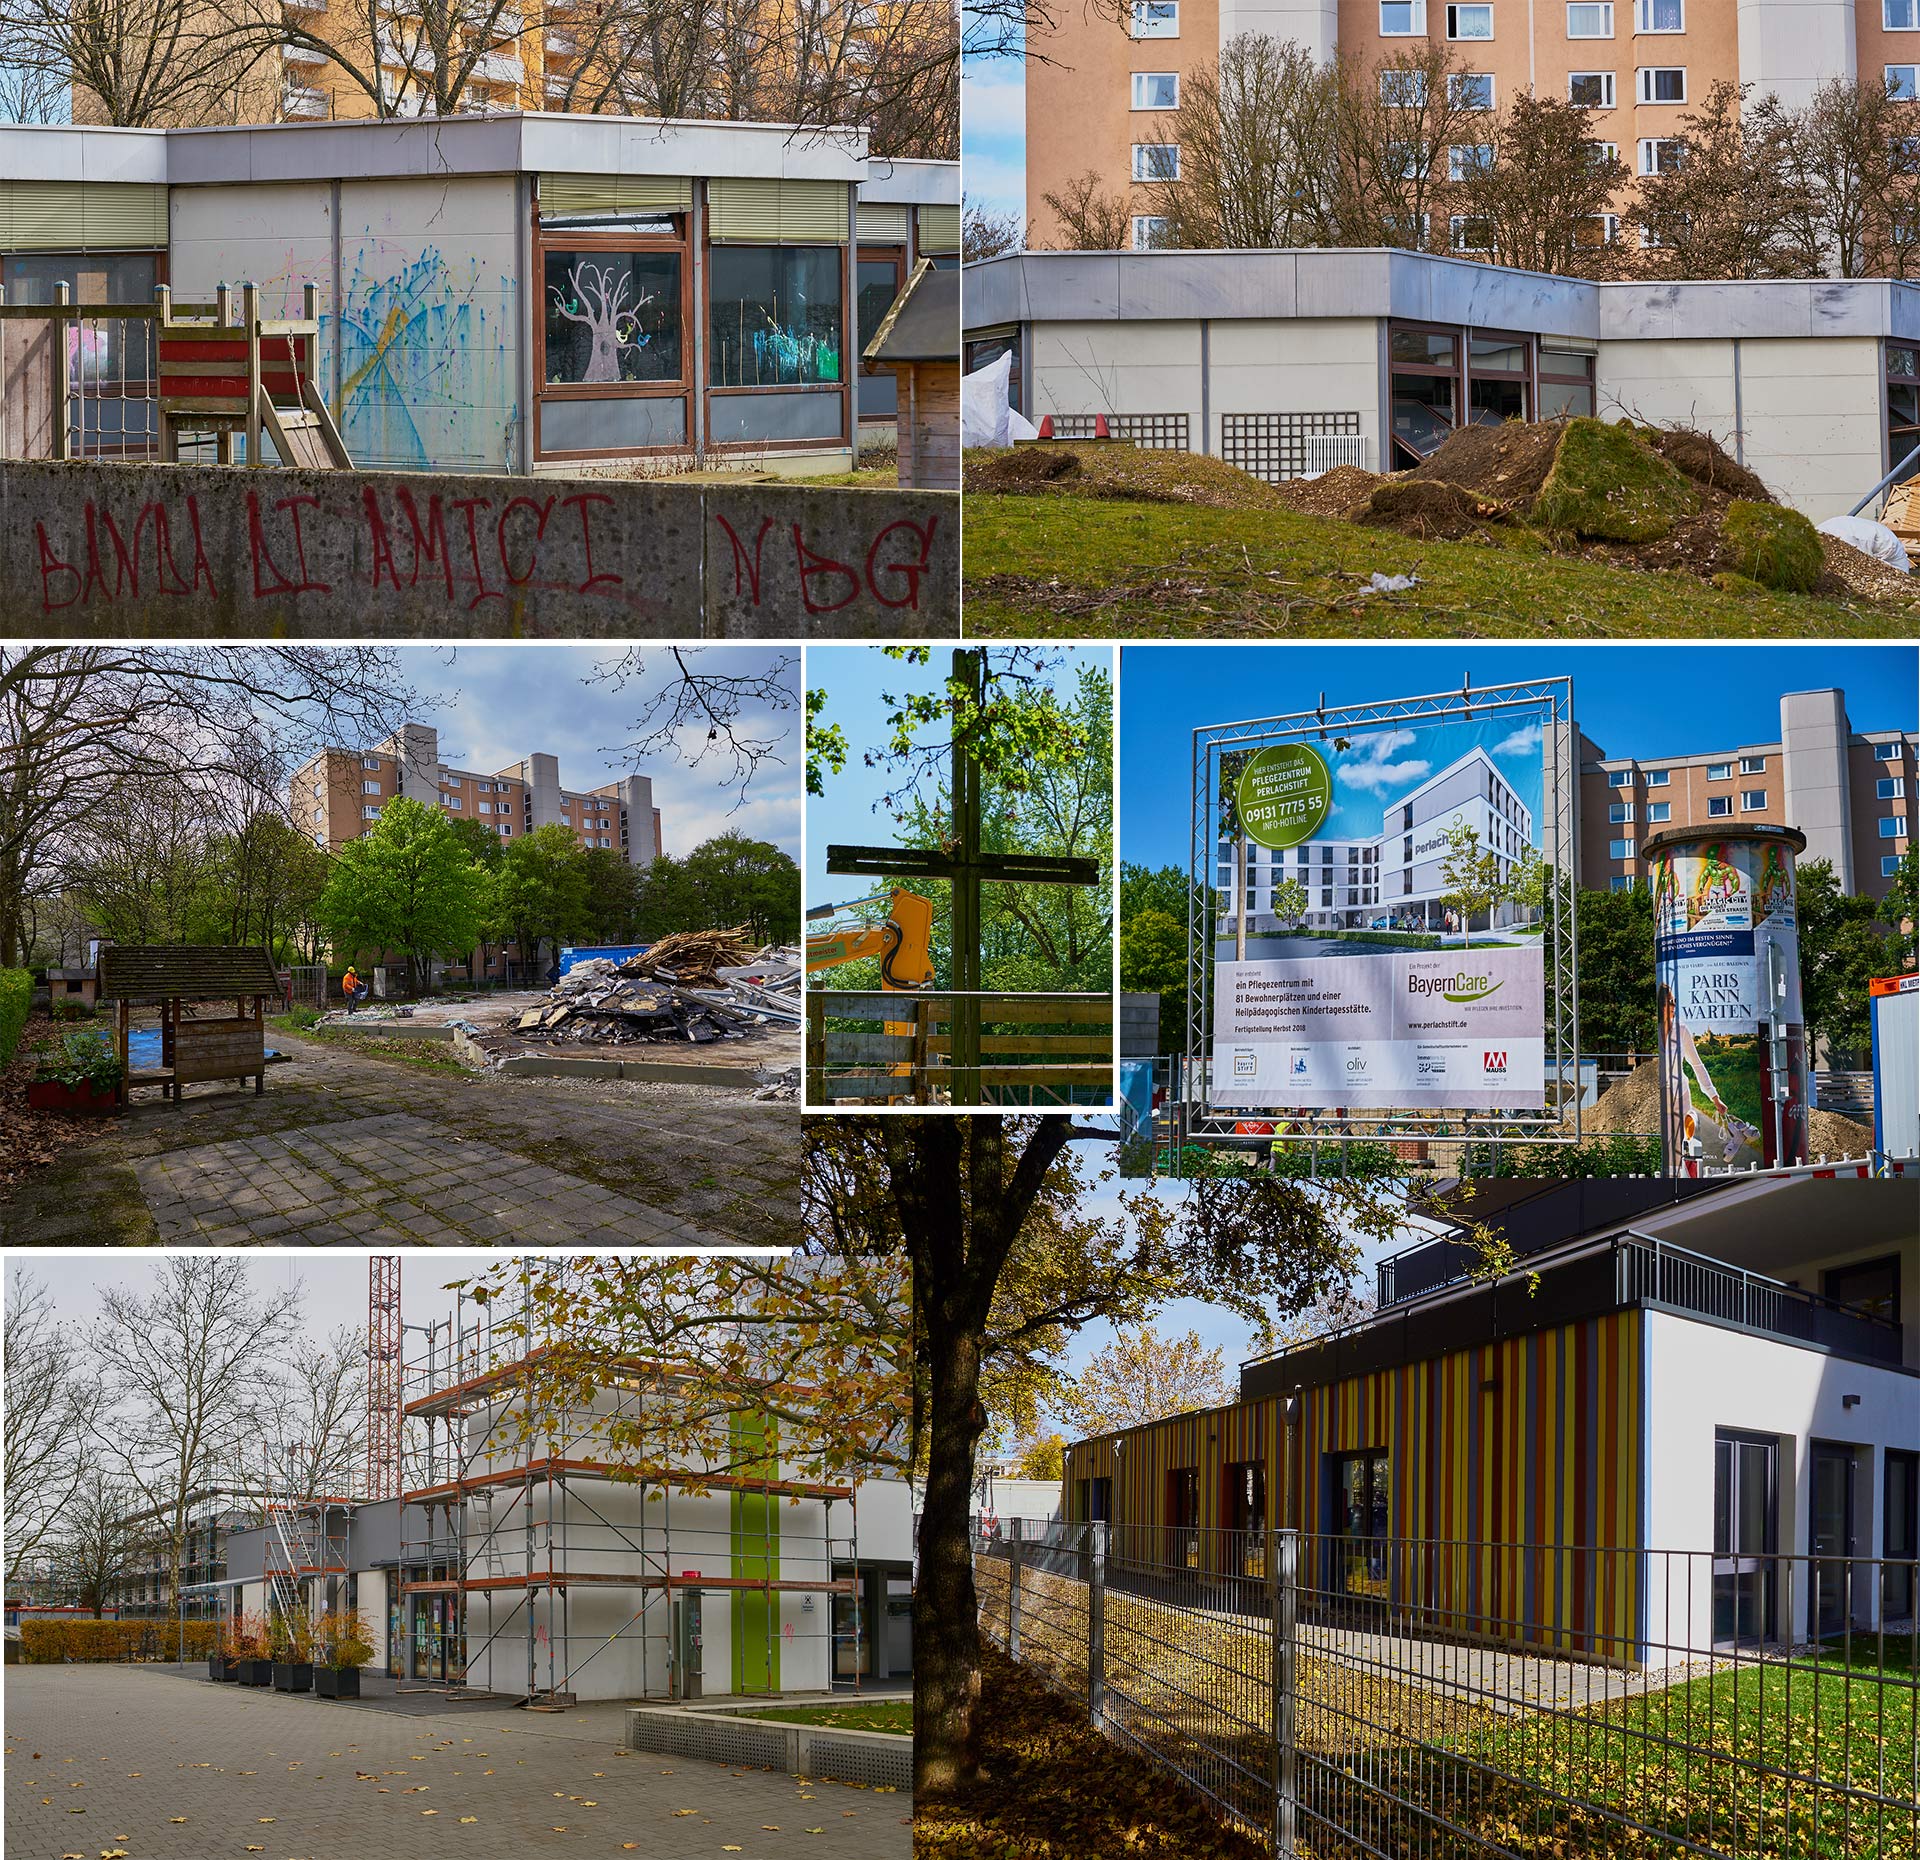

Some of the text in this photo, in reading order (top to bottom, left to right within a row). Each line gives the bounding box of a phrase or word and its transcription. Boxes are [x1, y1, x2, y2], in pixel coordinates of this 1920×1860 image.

[363, 485, 623, 611] AMICI
[1254, 758, 1304, 775] HIER ENTSTEHT DAS
[1252, 766, 1312, 787] PFLEGEZENTRUM
[1257, 778, 1308, 797] PERLACHSTIFT
[1246, 796, 1323, 823] 09131 7775 55
[1262, 814, 1308, 831] INFO-HOTLINE
[1235, 978, 1314, 991] ein Pflegezentrum mit
[1408, 972, 1488, 997] BayernCare
[1691, 973, 1739, 989] PARIS
[1235, 991, 1342, 1003] 81 Bewohnerplätzen und einer
[1688, 989, 1740, 1004] KANN
[1235, 1004, 1372, 1018] Heilpädagogischen Kindertagesstätte.
[1682, 1004, 1752, 1019] WARTEN
[1234, 1025, 1272, 1034] Fertigstellung
[1292, 1024, 1306, 1032] 2018
[1408, 1020, 1468, 1030] www.perlachstift.de
[1346, 1057, 1367, 1071] oliv
